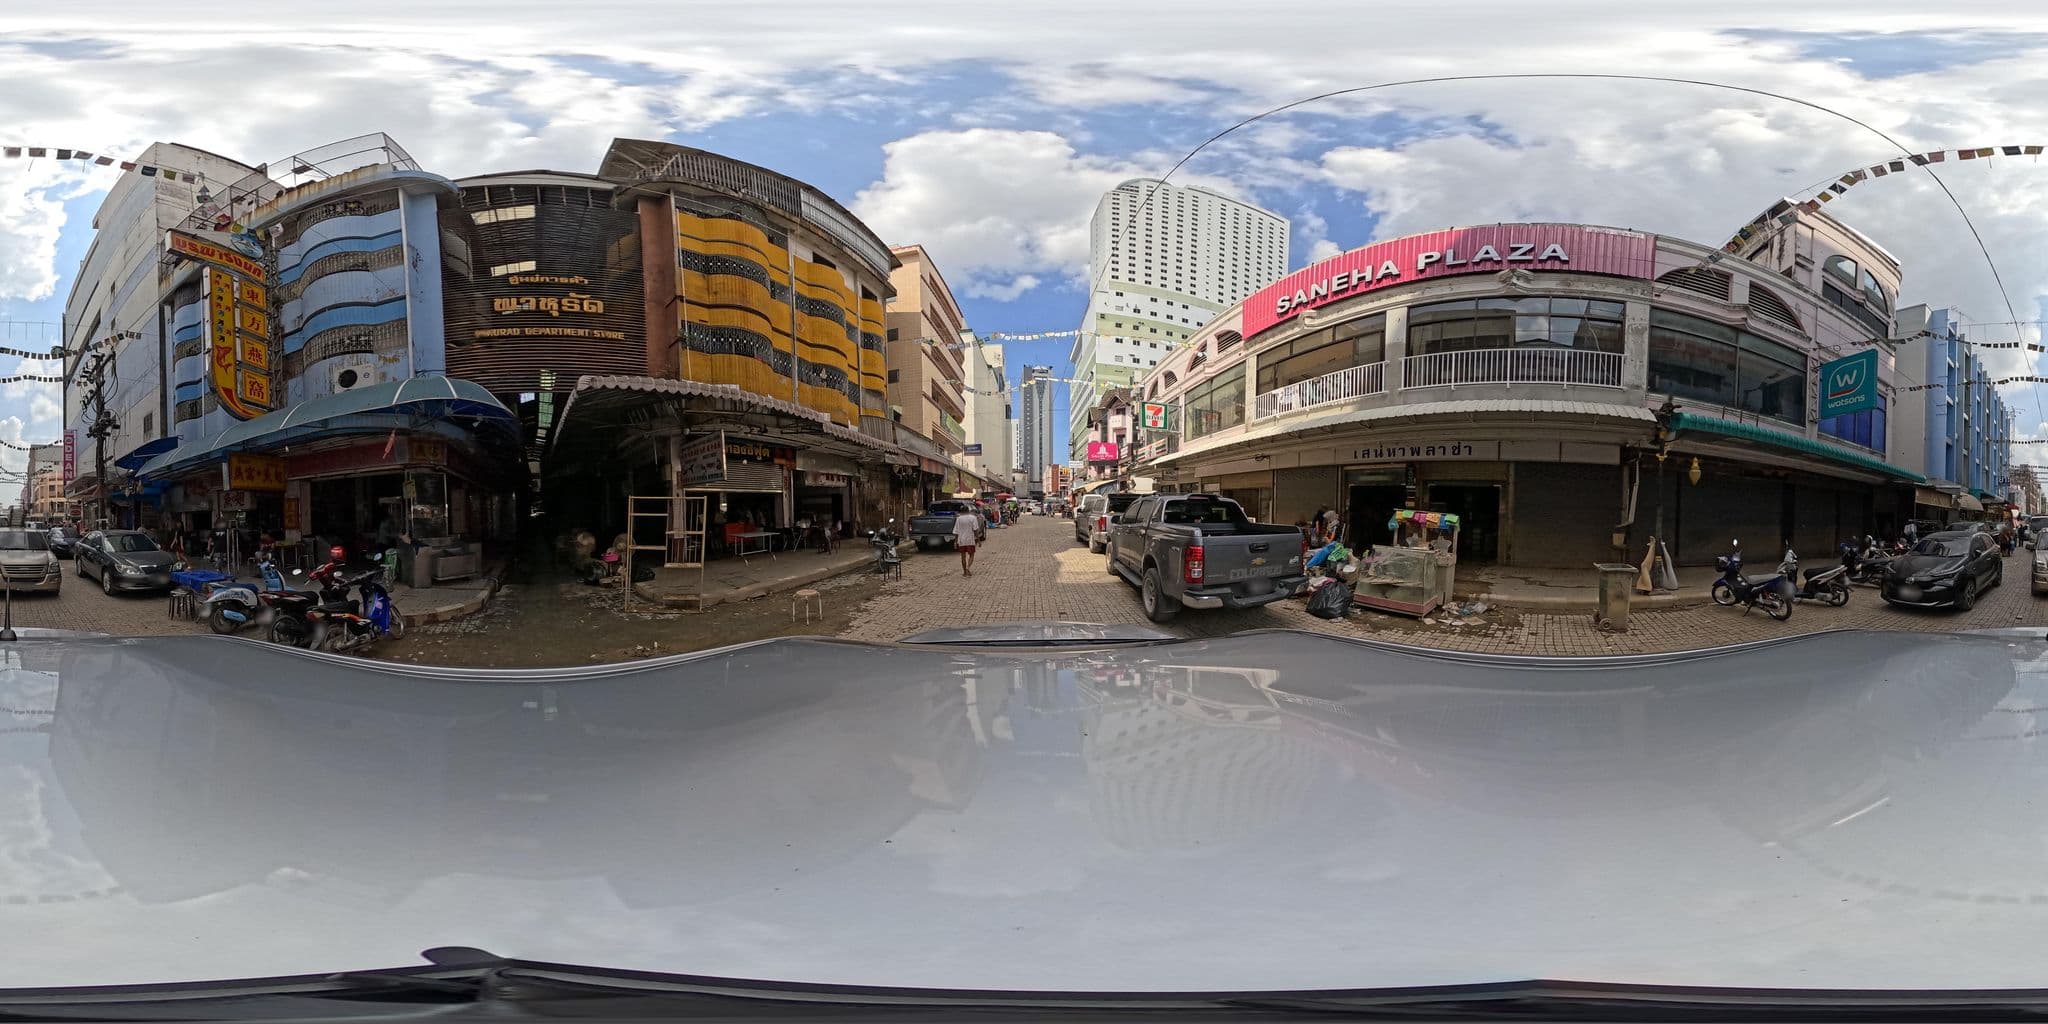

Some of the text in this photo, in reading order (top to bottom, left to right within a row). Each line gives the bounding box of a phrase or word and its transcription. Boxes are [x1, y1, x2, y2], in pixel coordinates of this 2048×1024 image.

[1276, 243, 1570, 314] SANEHA PLAZA
[493, 292, 605, 317] พาหุรัด
[474, 327, 625, 340] HURAD DEPARTMENT STORE
[1827, 394, 1866, 409] watsons
[64, 436, 73, 479] ODEAN
[1353, 441, 1473, 460] เสน่หาพลาซ่า
